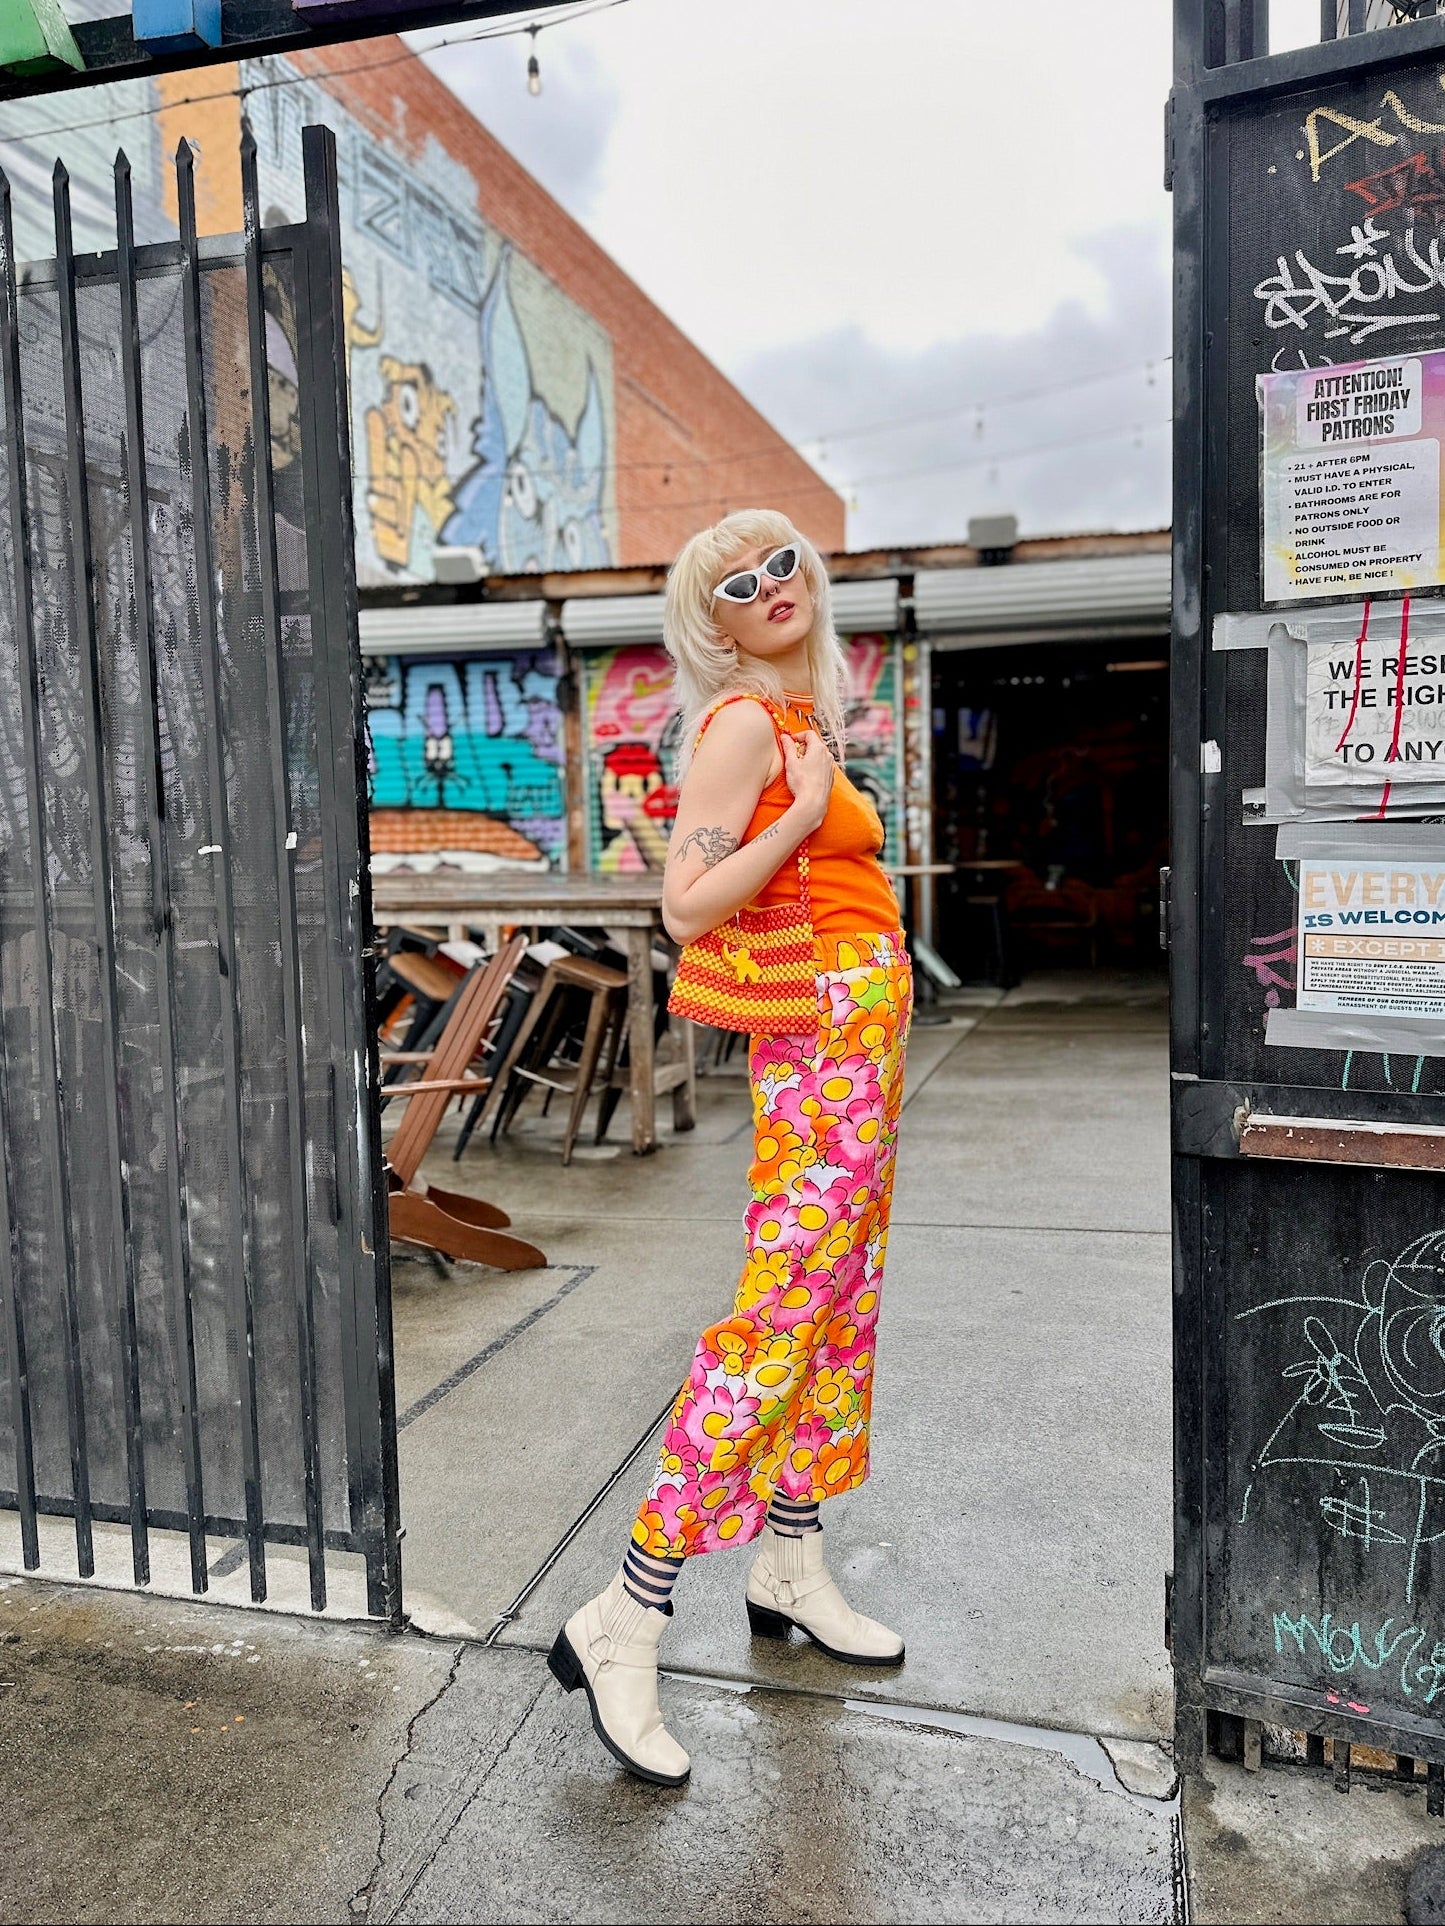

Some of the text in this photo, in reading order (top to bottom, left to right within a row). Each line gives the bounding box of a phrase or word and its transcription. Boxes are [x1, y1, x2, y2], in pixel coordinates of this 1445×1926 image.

[1315, 368, 1402, 399] ATTENTION!
[1307, 389, 1410, 422] FIRST FRIDAY
[1322, 414, 1394, 442] PATRONS
[1294, 463, 1305, 471] 21
[1316, 458, 1347, 468] AFTER
[1349, 454, 1370, 463] 6PM
[1294, 474, 1321, 483] MUST
[1324, 470, 1351, 480] HAVE
[1362, 462, 1415, 475] PHYSICAL,
[1294, 478, 1392, 496] VALID I.D. TO ENTER
[1294, 490, 1401, 509] BATHROOMS ARE FOR
[1294, 507, 1370, 521] PATRONS ONLY
[1295, 516, 1400, 535] NO OUTSIDE FOOD OR
[1295, 538, 1325, 547] DRINK
[1295, 549, 1341, 560] ALCOHOL
[1343, 546, 1371, 555] MUST
[1295, 553, 1422, 573] CONSUMED ON PROPERTY
[1295, 576, 1322, 585] HAVE
[1324, 574, 1346, 583] FUN,
[1329, 660, 1371, 680] WE
[1323, 689, 1377, 709] THE
[1340, 743, 1375, 763] TO
[1305, 914, 1333, 928] IS
[1333, 940, 1431, 957] EXCEPT
